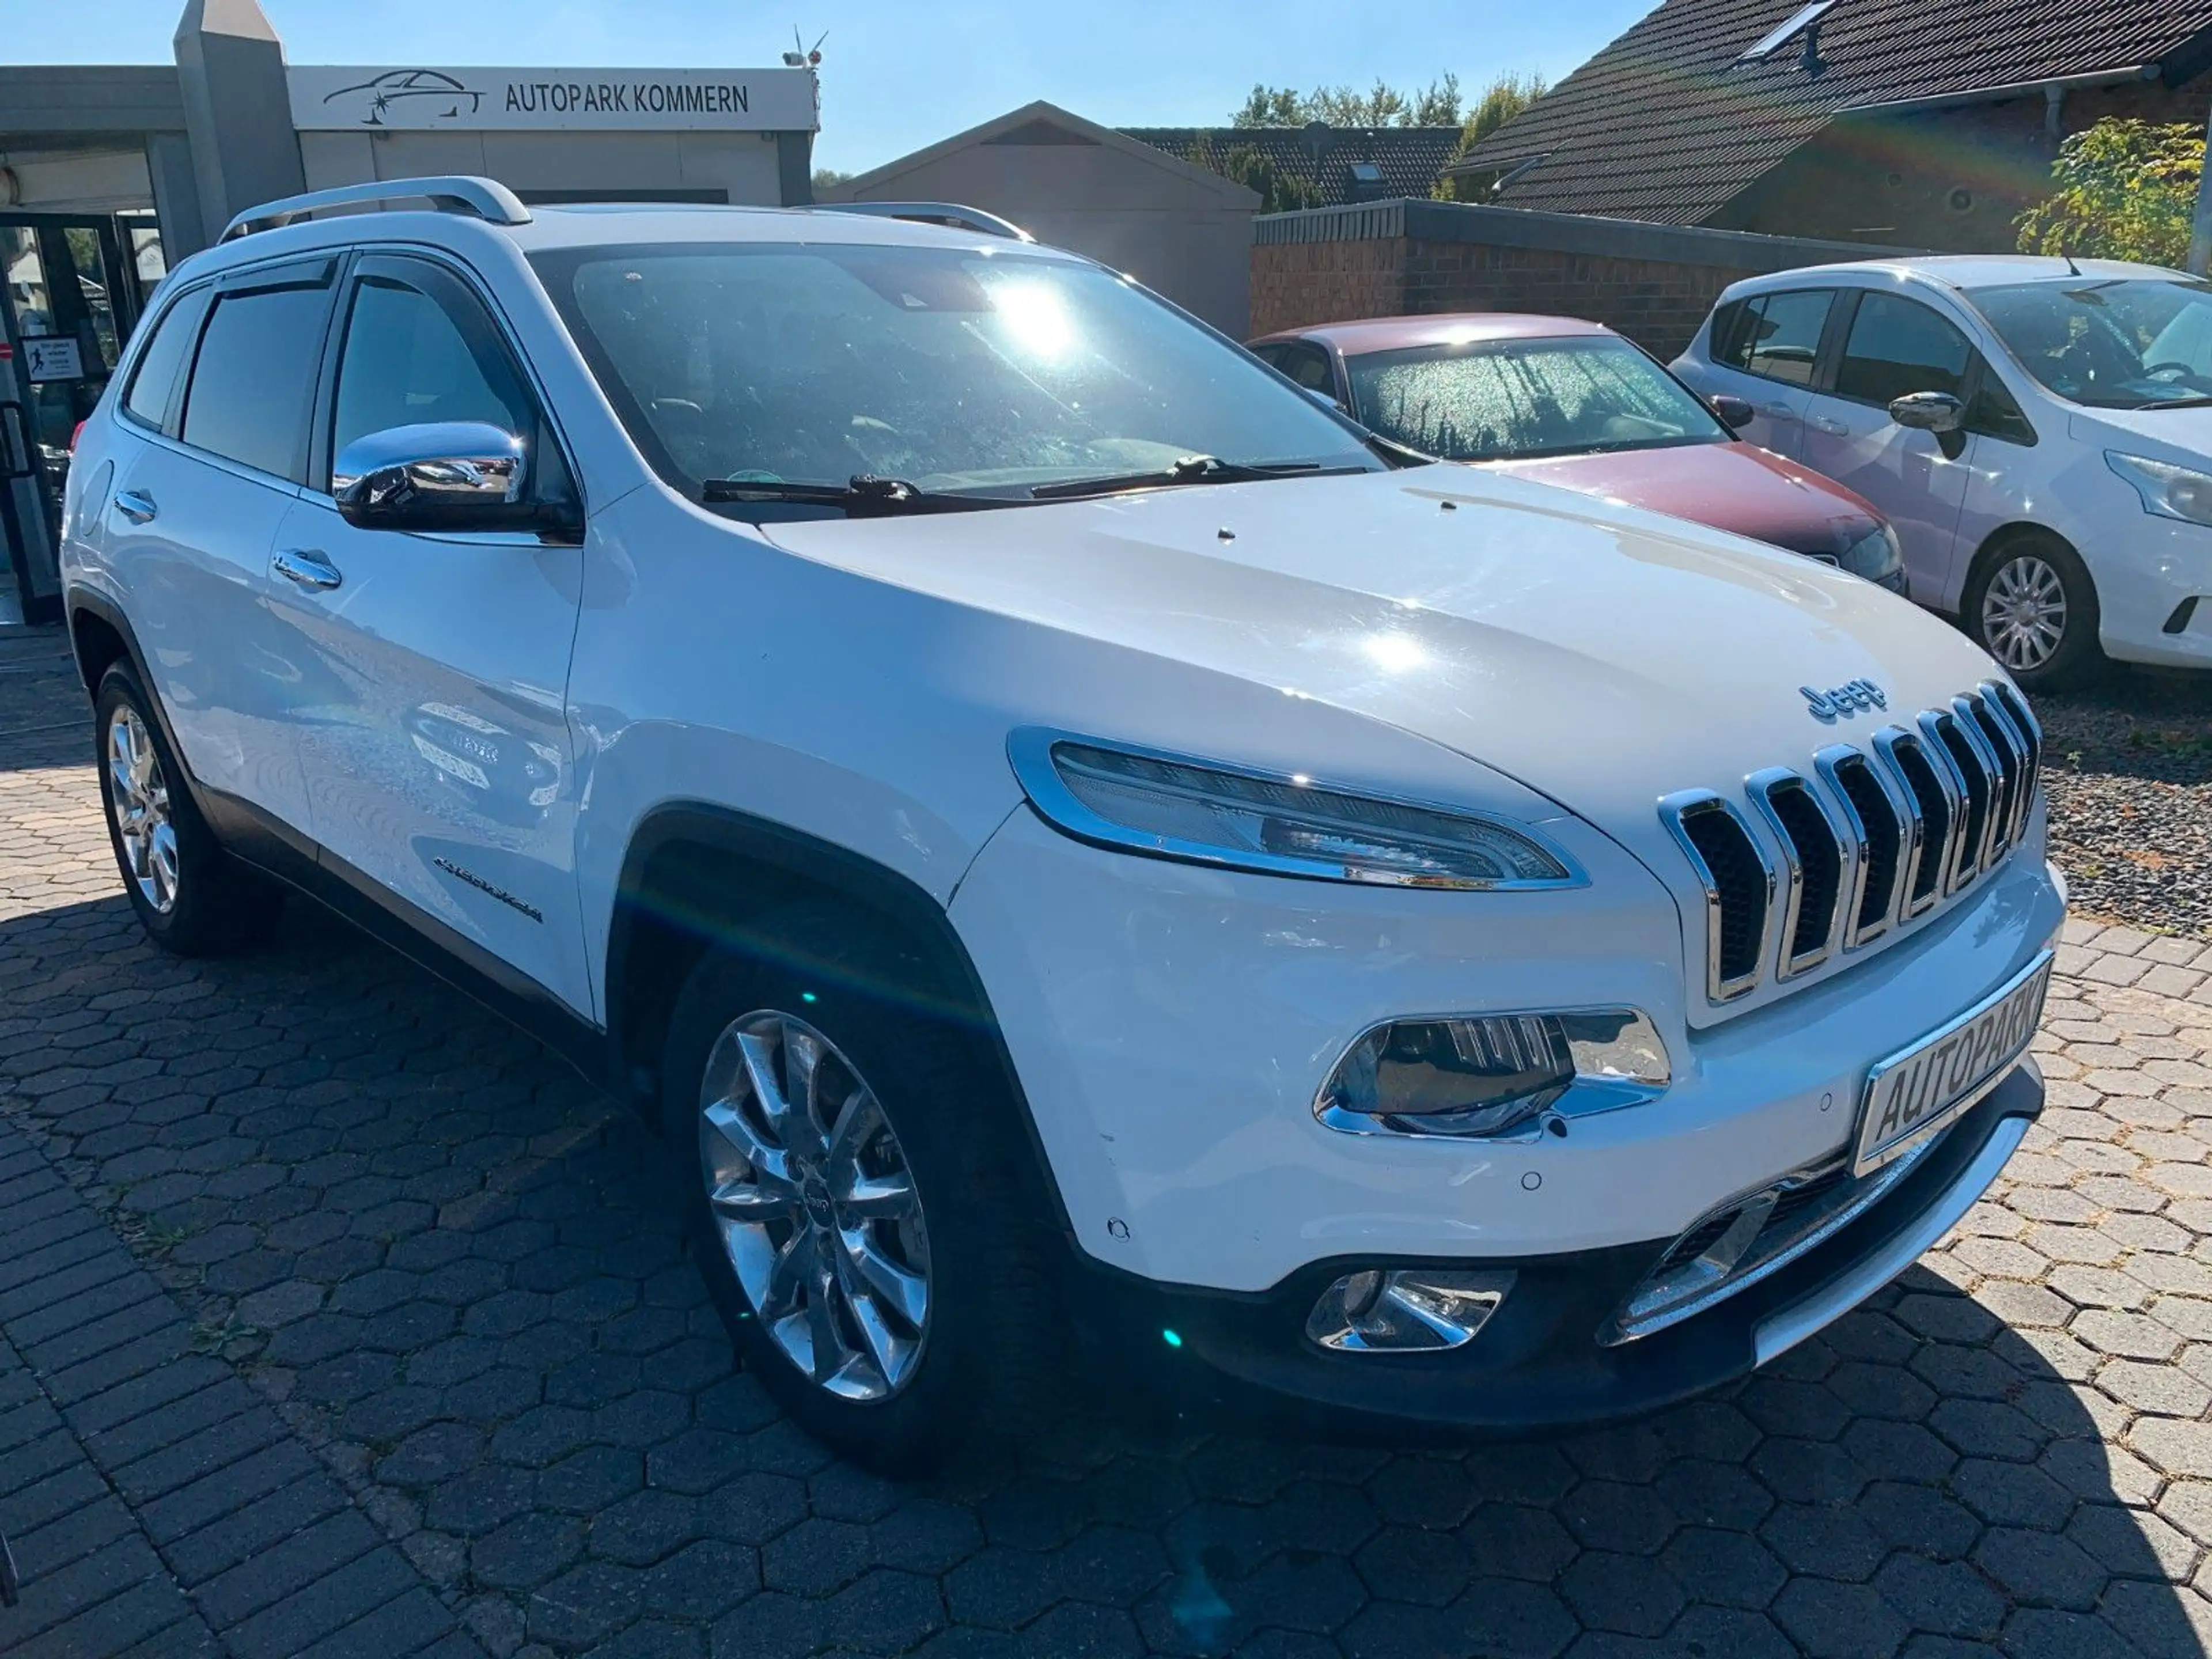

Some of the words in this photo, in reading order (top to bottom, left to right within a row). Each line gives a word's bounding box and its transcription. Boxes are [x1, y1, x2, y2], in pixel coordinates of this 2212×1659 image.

[506, 84, 629, 112] AUTOPARK
[634, 84, 748, 113] KOMMERN
[1799, 679, 1886, 718] Jeep
